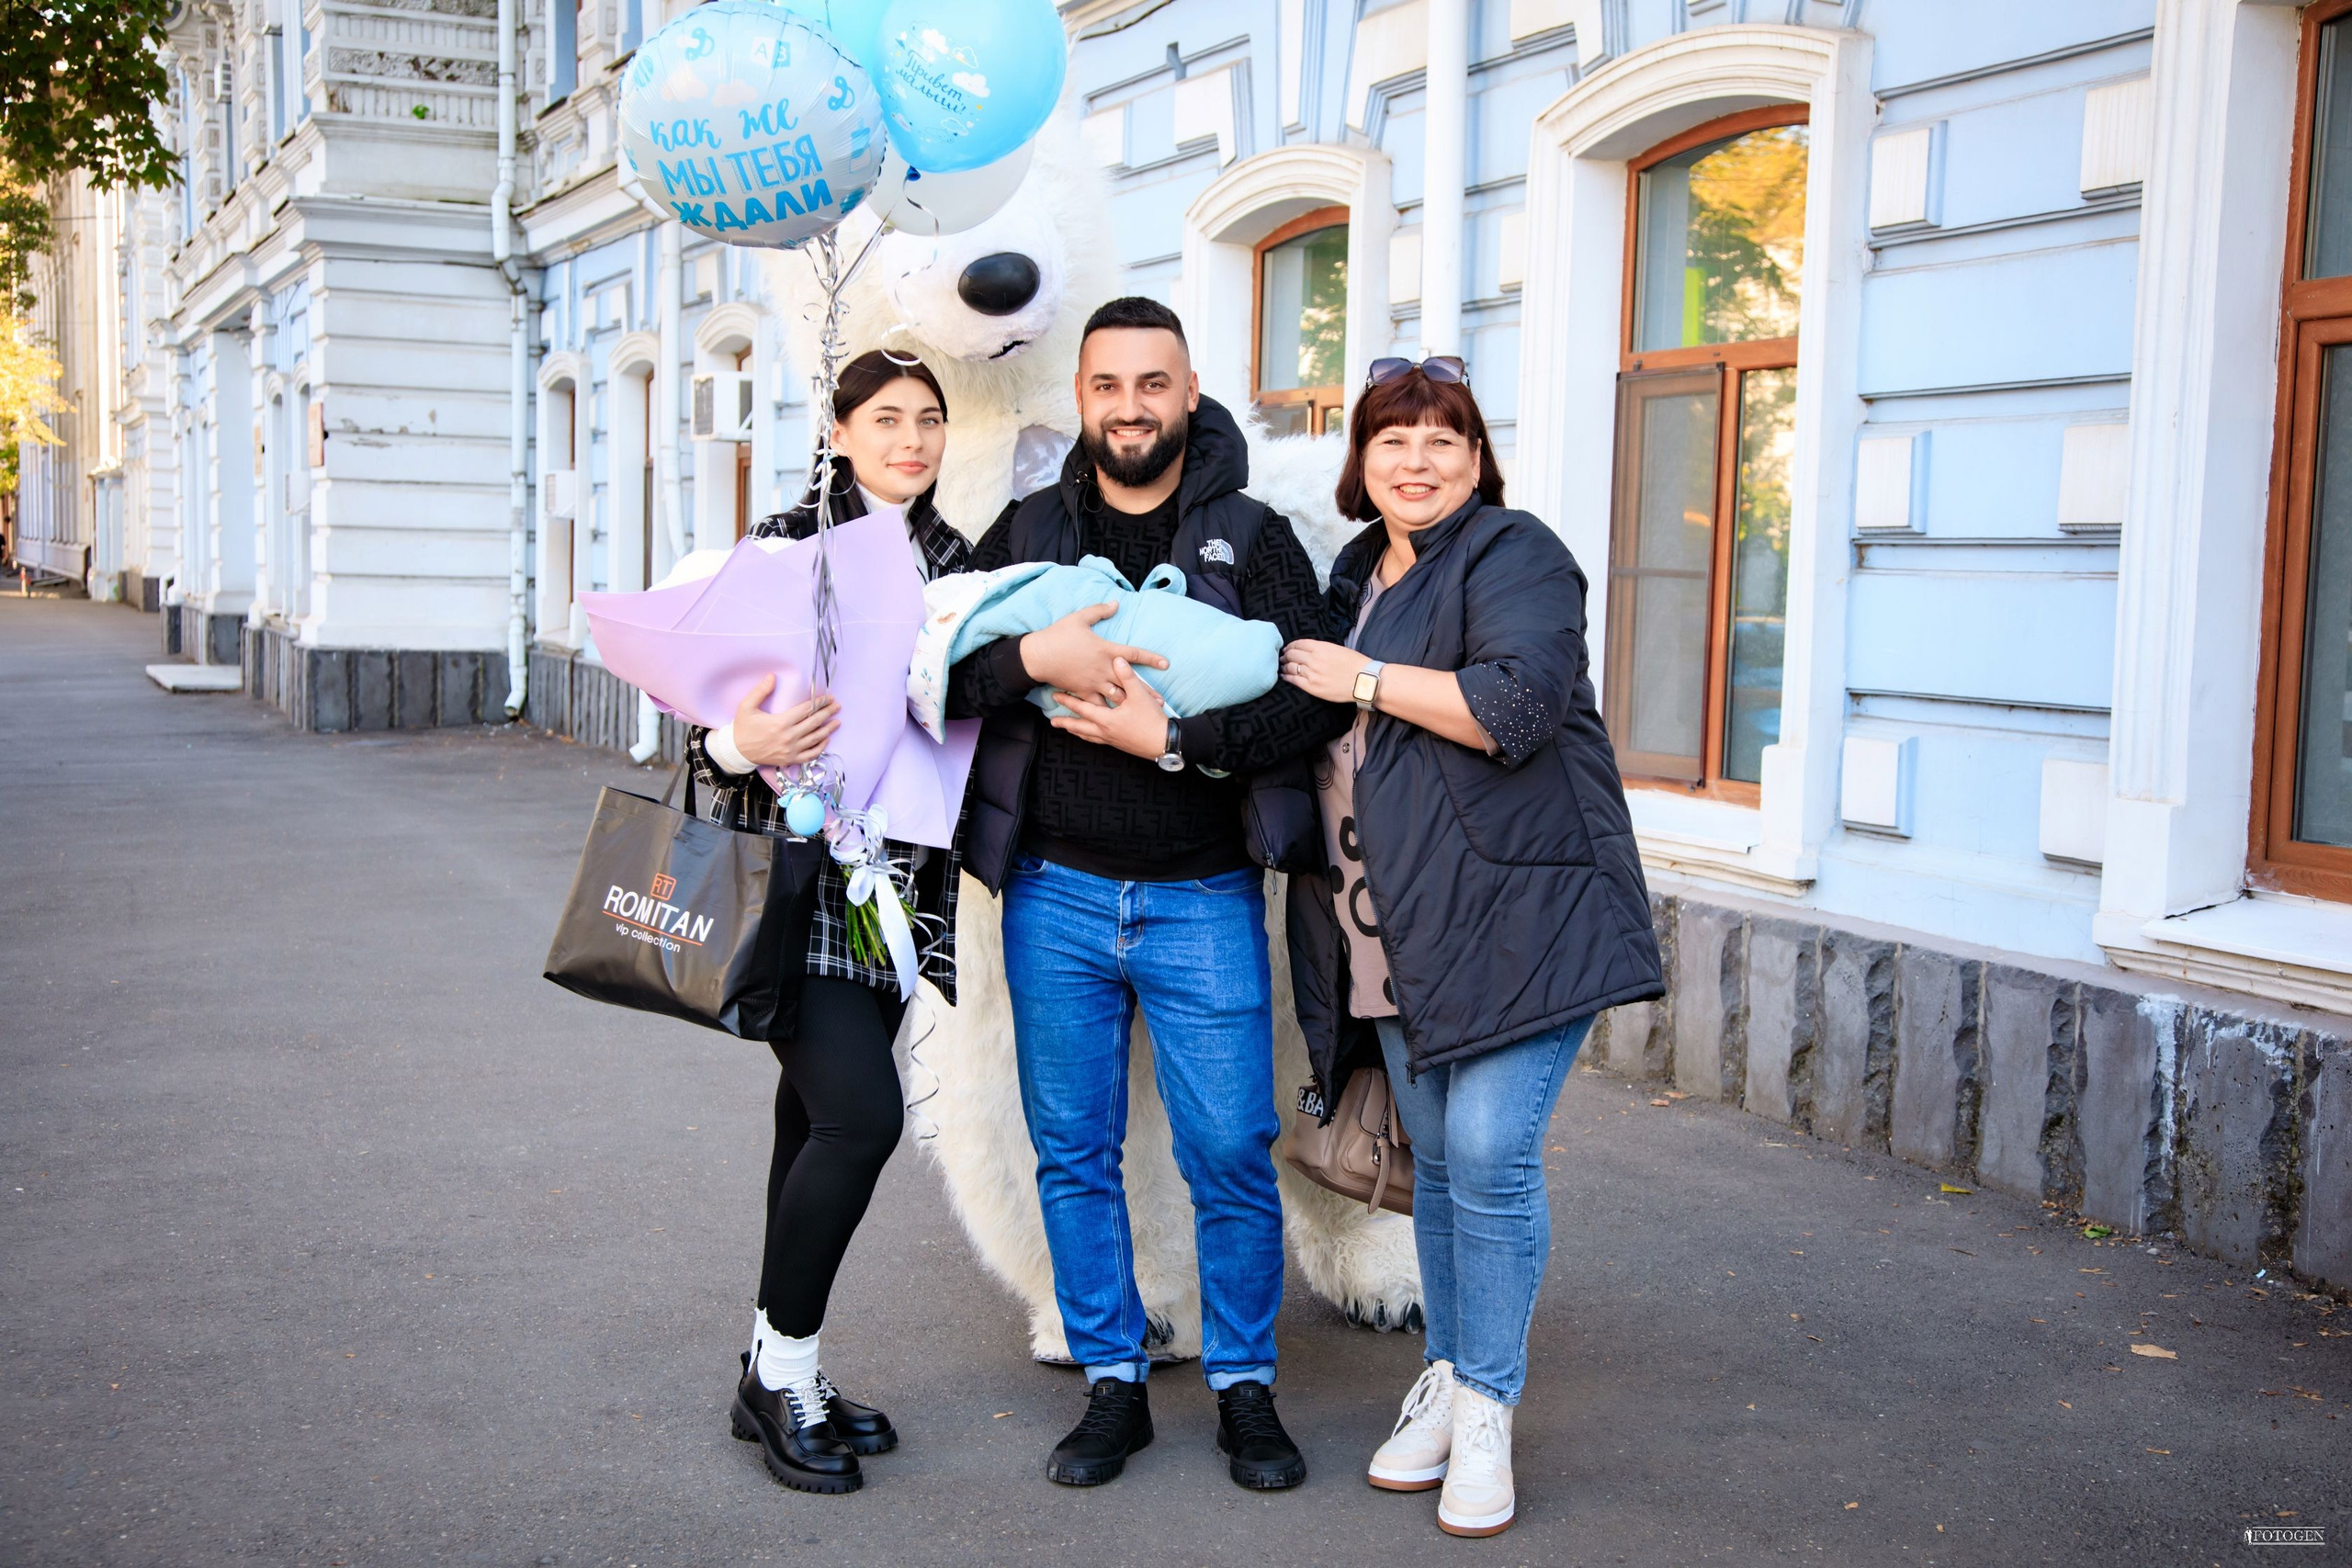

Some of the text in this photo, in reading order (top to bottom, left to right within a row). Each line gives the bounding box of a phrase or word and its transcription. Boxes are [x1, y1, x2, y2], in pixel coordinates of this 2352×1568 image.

[905, 50, 962, 101] Привет
[650, 98, 798, 152] как же
[656, 134, 823, 198] МЫ ТЕБЯ
[670, 178, 834, 231] ЖДАЛИ
[1199, 547, 1221, 556] NORTH
[1204, 553, 1222, 562] FACE
[1206, 538, 1221, 547] THE
[603, 885, 714, 942] ROMITAN
[616, 922, 681, 953] vip collection
